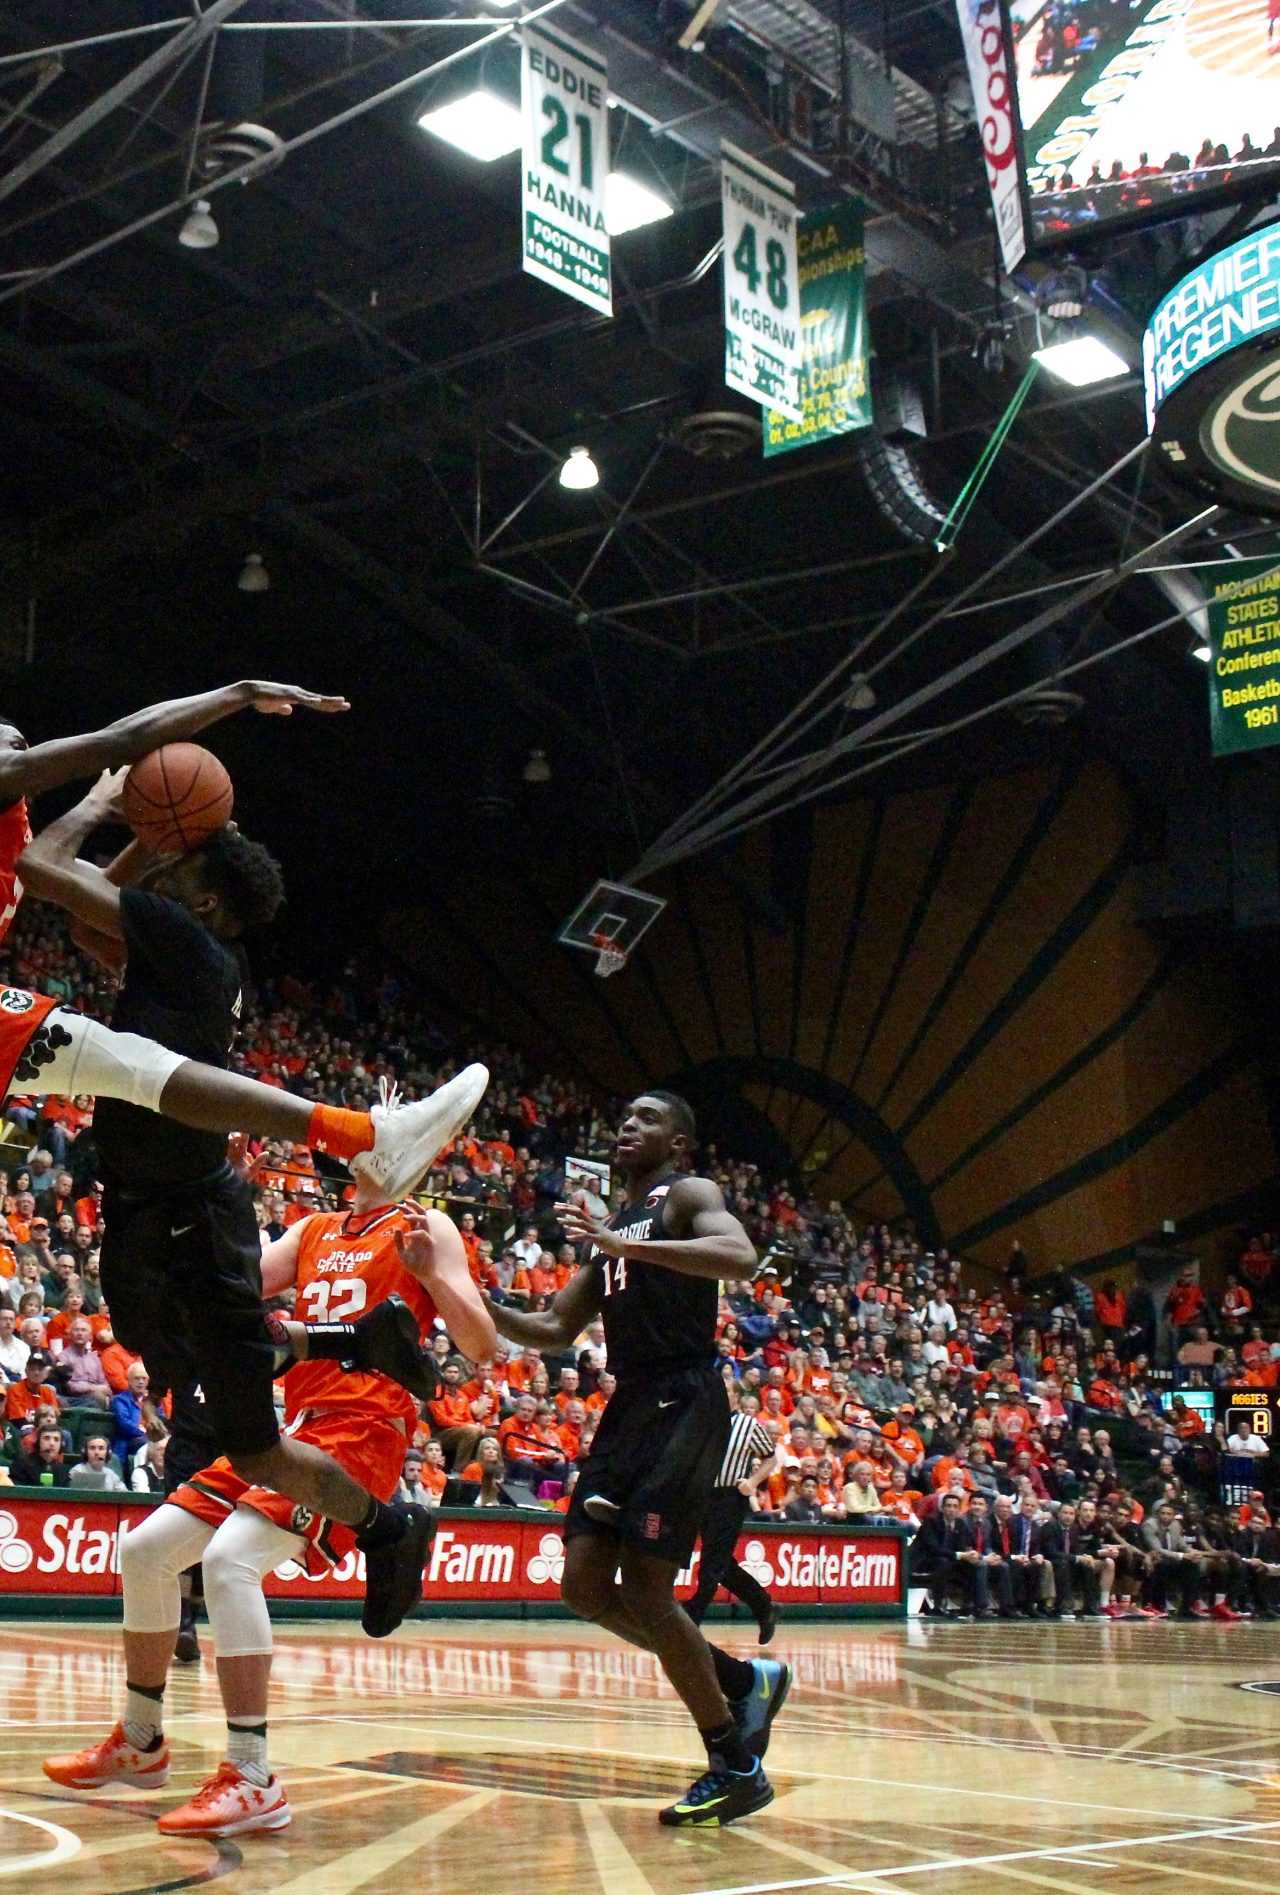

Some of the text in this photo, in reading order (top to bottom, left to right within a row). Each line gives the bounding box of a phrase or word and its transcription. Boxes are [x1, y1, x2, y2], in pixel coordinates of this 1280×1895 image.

[529, 48, 602, 108] EDDIE
[541, 94, 593, 192] 21
[528, 170, 608, 236] HANNA
[533, 218, 602, 272] FOOTBALL
[733, 222, 789, 312] 48
[729, 296, 796, 351] McGRAW
[1227, 597, 1279, 625] STATES
[1245, 704, 1278, 729] 1961
[302, 1278, 368, 1323] 32
[602, 1256, 628, 1297] 14
[1231, 1393, 1269, 1406] AGGIES
